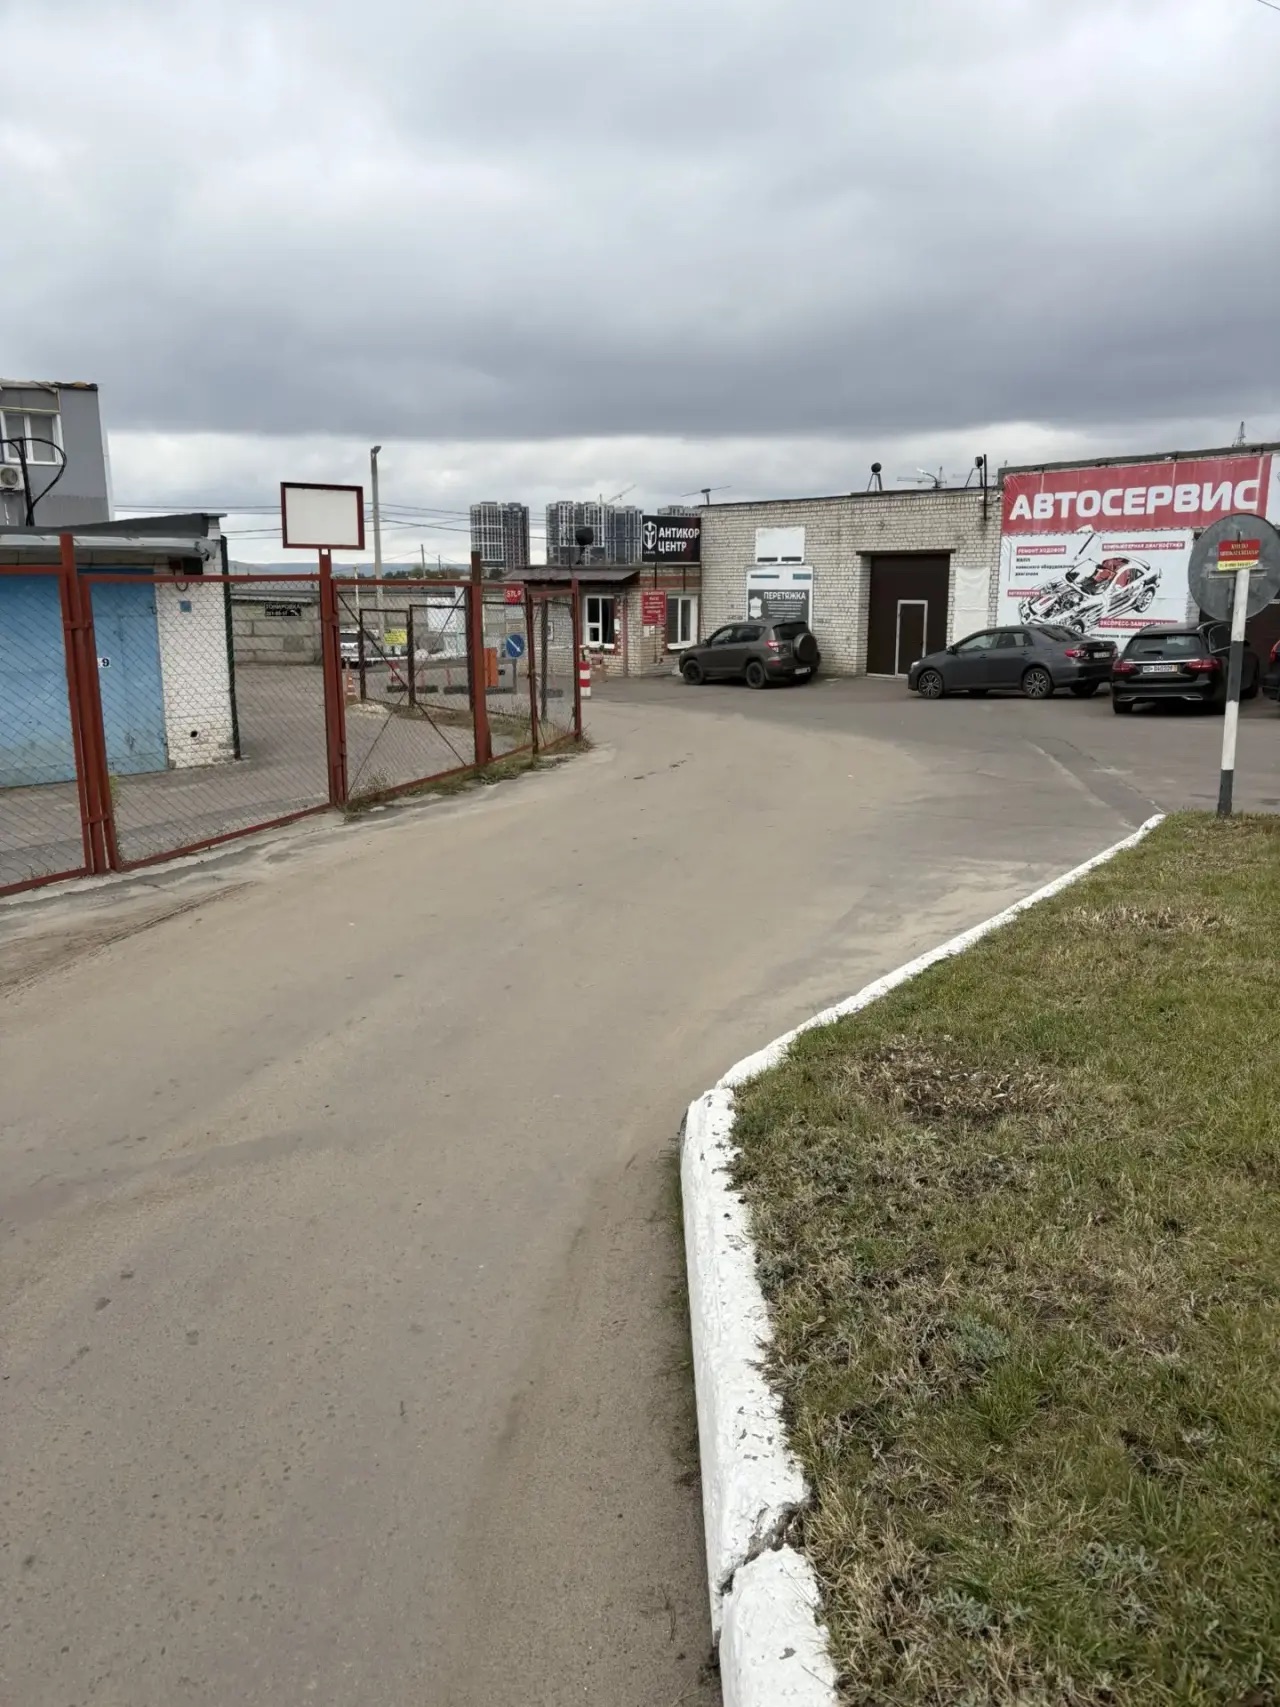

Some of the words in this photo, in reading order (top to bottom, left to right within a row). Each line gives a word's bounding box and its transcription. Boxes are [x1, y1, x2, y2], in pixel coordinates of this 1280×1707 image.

[1009, 478, 1260, 521] АВТОСЕРВИС
[658, 526, 700, 539] АНТИКОР
[657, 540, 687, 554] ЦЕНТР
[763, 591, 807, 600] ПЕРЕТЯЖКА
[102, 658, 110, 667] 9
